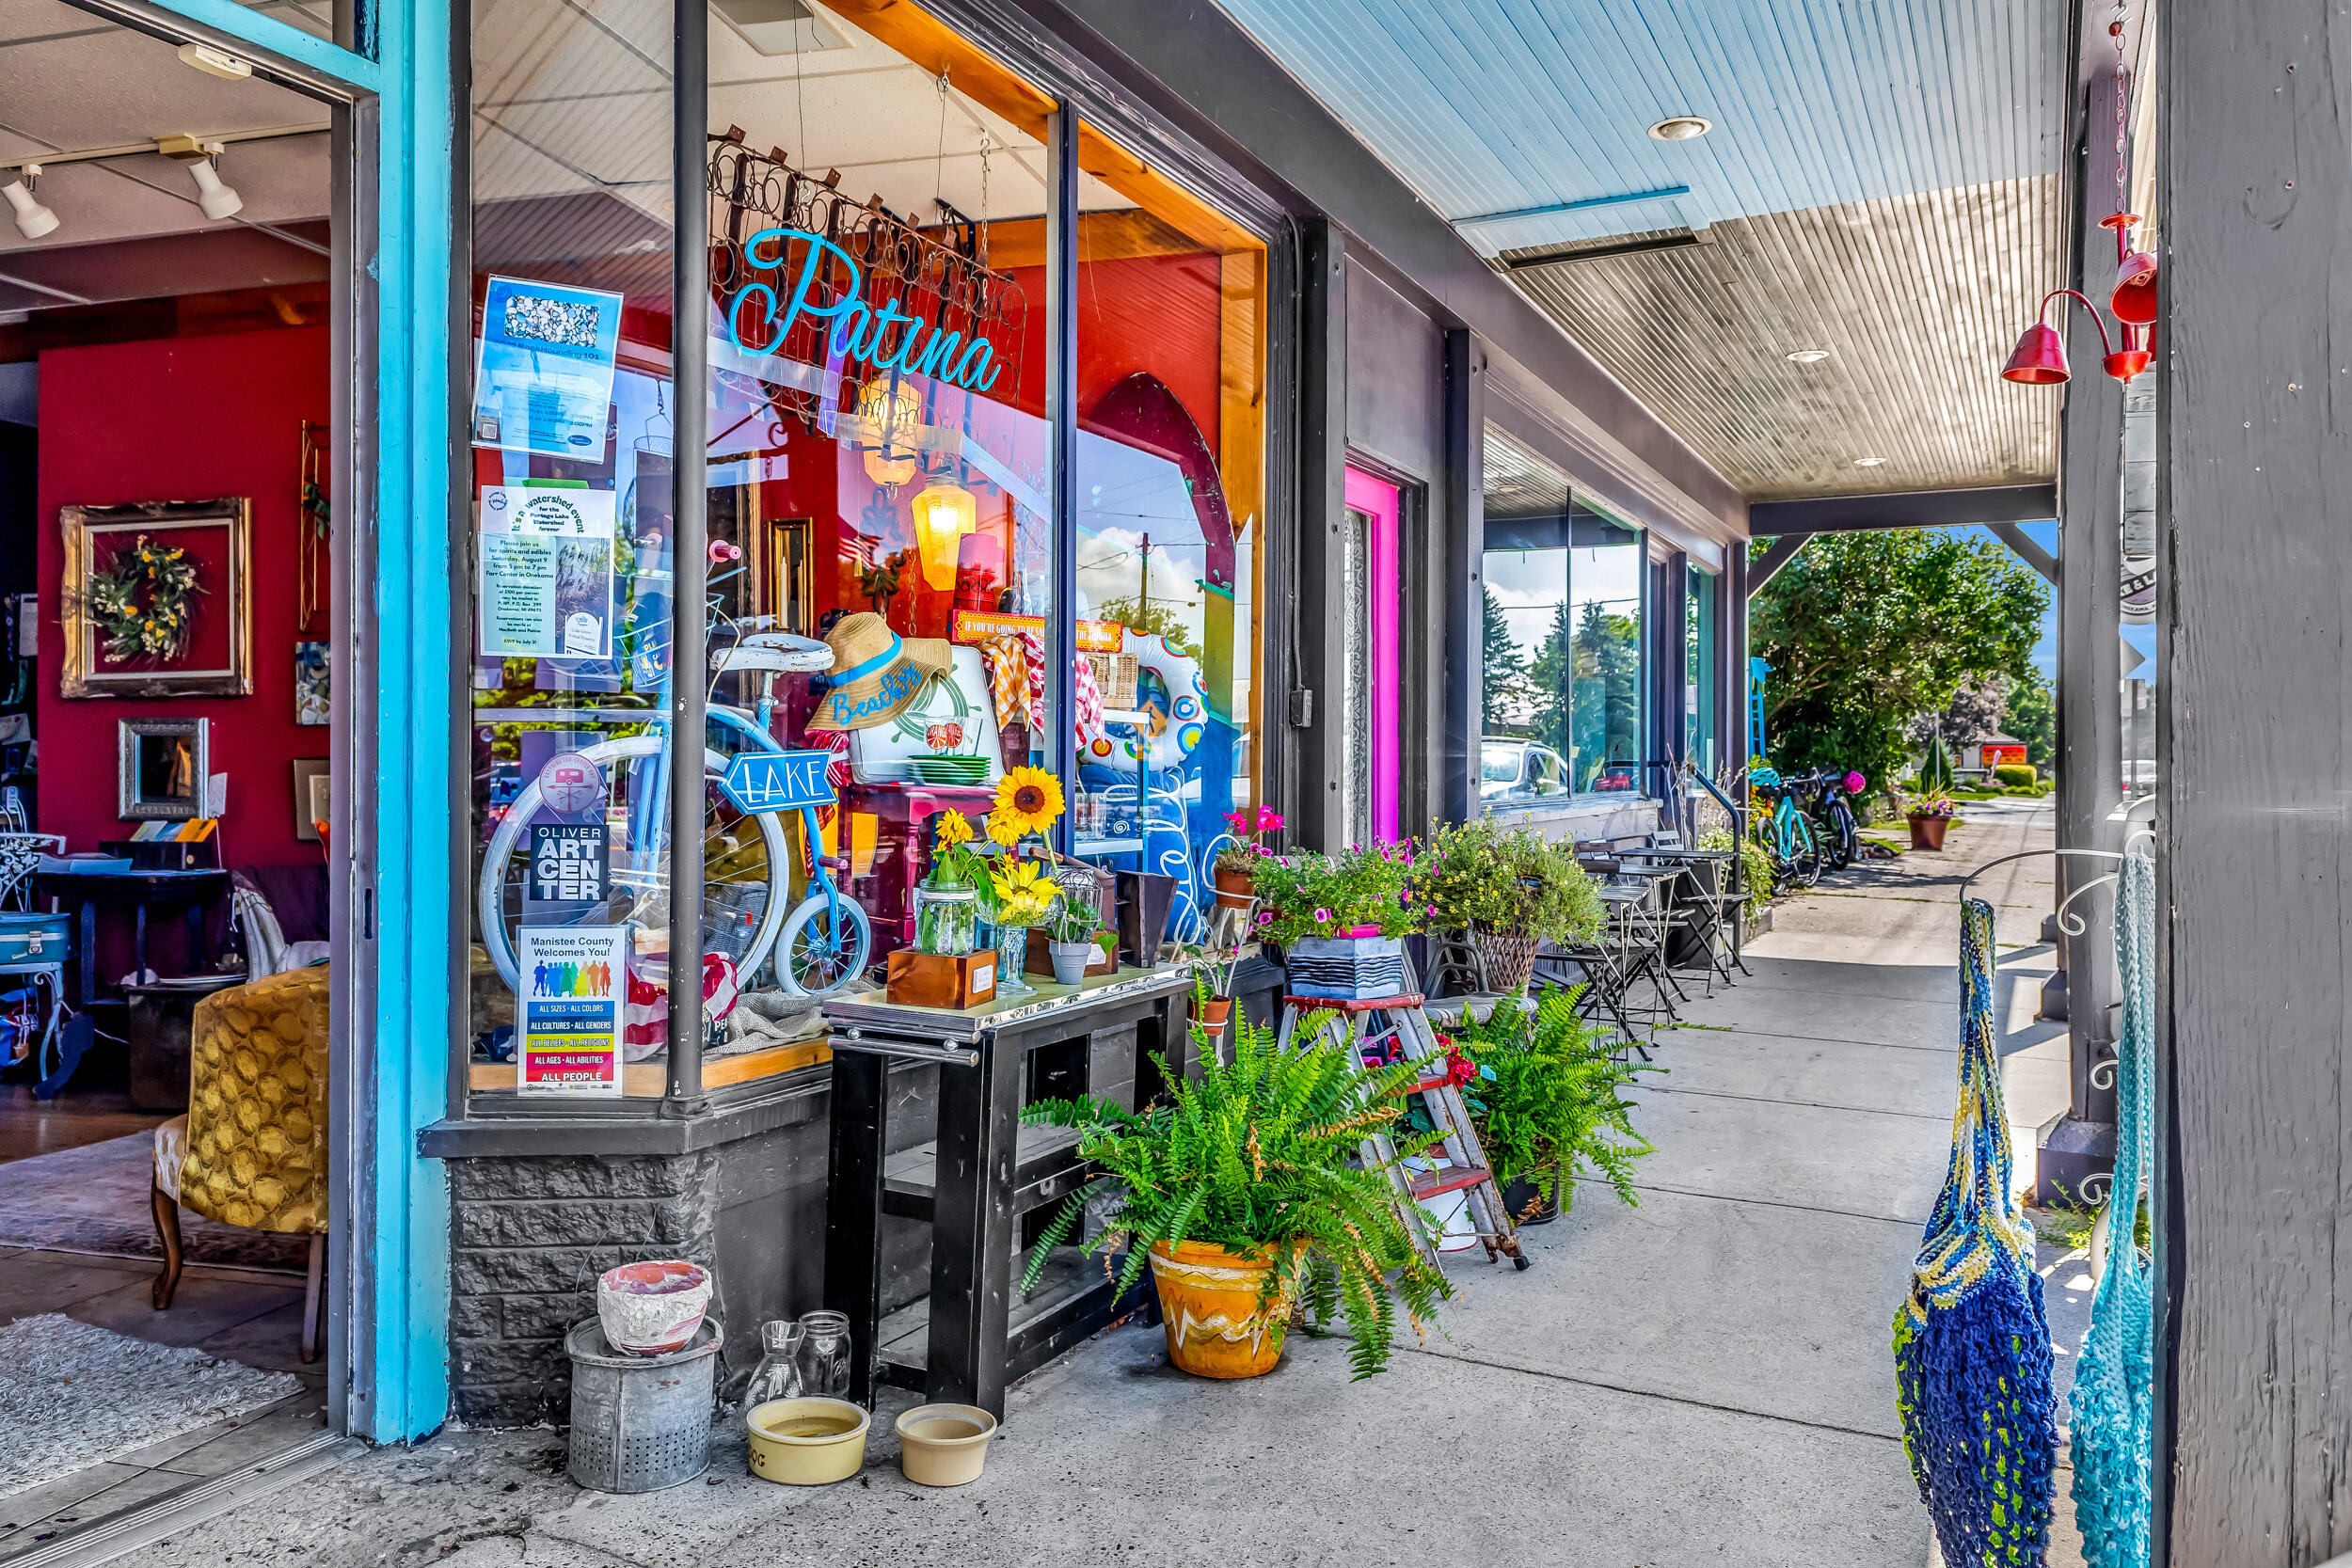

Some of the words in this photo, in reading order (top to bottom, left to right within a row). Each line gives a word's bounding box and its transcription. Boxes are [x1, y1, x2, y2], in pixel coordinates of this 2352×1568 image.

[729, 228, 1001, 392] Patina
[512, 516, 522, 531] It's
[525, 496, 574, 511] watershed
[571, 509, 584, 533] event
[965, 621, 971, 631] IF
[972, 622, 994, 633] YOU'RE
[996, 624, 1016, 634] GOING
[829, 663, 922, 725] Beachy
[743, 760, 824, 803] LAKE
[538, 828, 601, 838] OLIVER
[537, 839, 600, 859] ART
[537, 859, 600, 879] CEN
[537, 879, 600, 900] TER
[531, 938, 576, 946] Manistee
[579, 937, 614, 947] County
[534, 948, 585, 957] Welcomes
[588, 948, 610, 957] You!
[542, 1022, 570, 1030] CULTURES
[543, 1038, 565, 1047] BELIEFS
[580, 1038, 610, 1047] RELIGIONS
[534, 1056, 545, 1065] ALL
[577, 1055, 604, 1064] ABILITIES
[541, 1072, 561, 1082] ALL
[563, 1072, 602, 1081] PEOPLE
